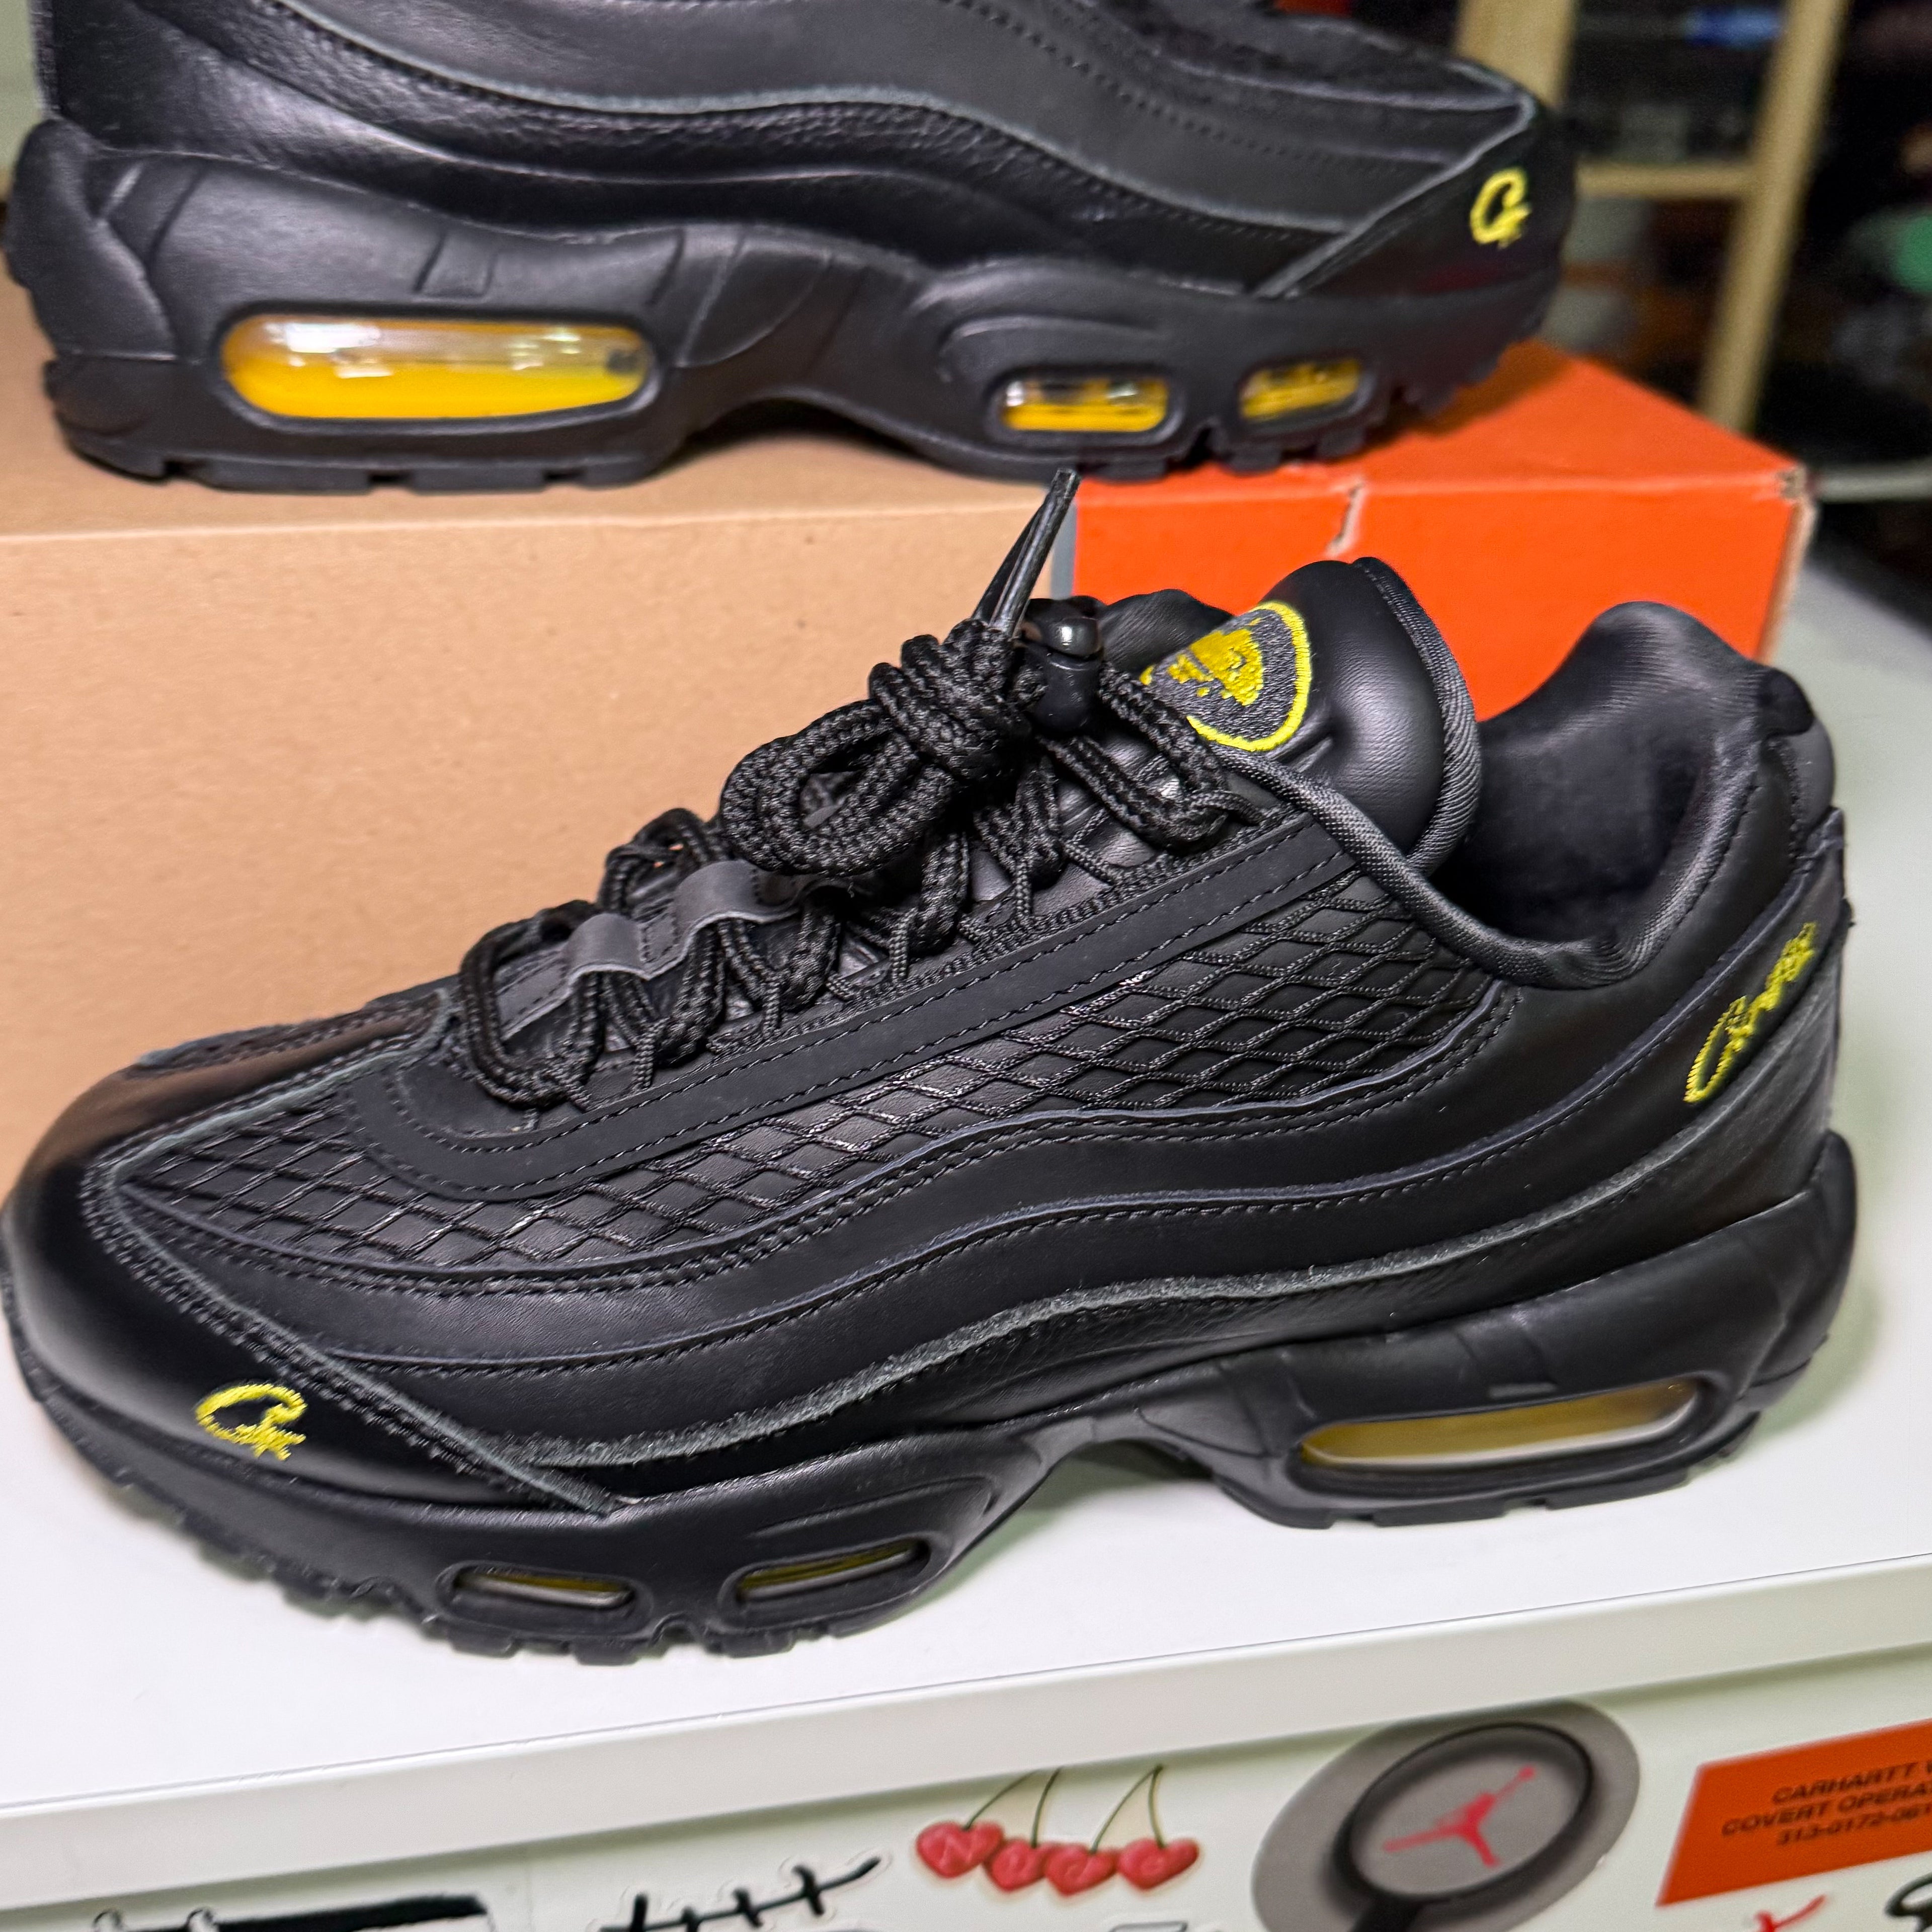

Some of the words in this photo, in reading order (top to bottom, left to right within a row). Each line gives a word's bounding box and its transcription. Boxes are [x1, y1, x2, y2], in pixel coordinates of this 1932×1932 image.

[1772, 1762, 1918, 1804] CARHARTT
[1721, 1800, 1832, 1837] COVERT
[1838, 1780, 1932, 1813] OPERA
